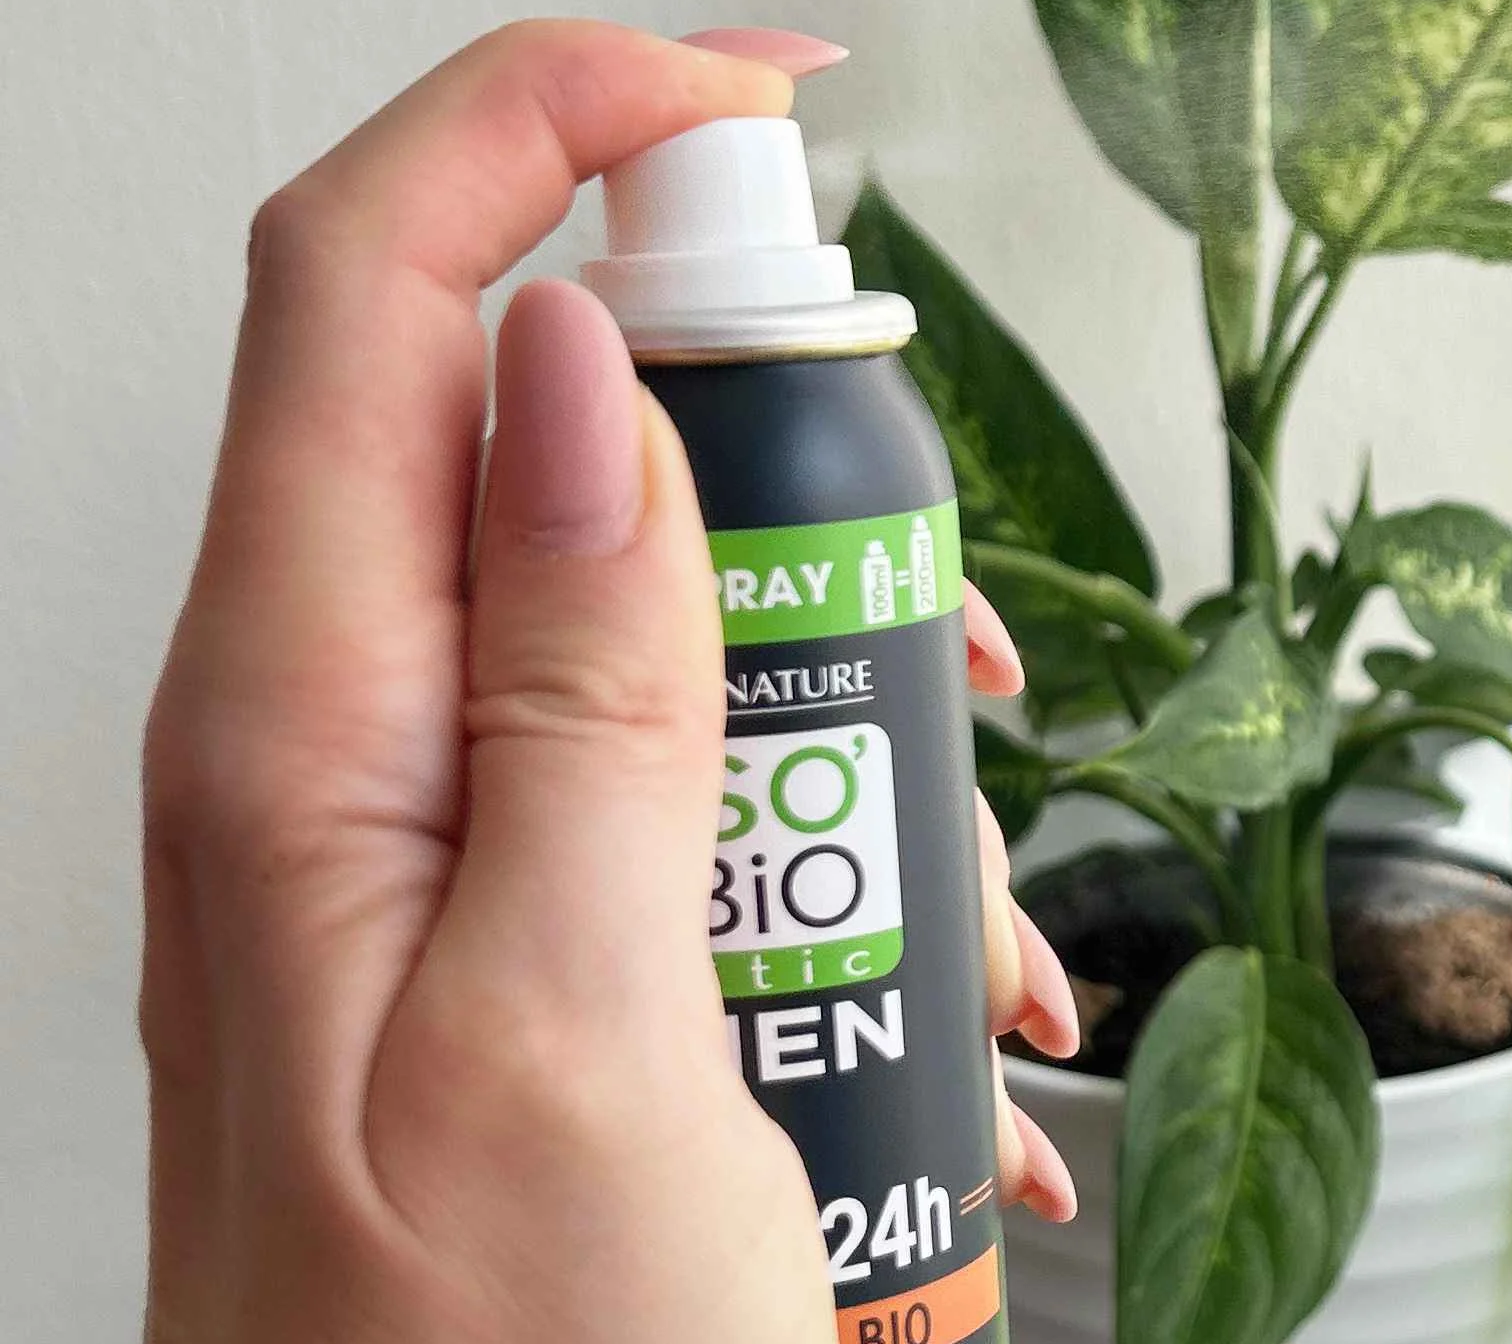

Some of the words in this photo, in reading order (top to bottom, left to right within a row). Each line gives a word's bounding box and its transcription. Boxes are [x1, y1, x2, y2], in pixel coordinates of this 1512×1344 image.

[715, 561, 833, 611] RAY
[726, 660, 874, 706] NATURE
[820, 1176, 952, 1284] 24h
